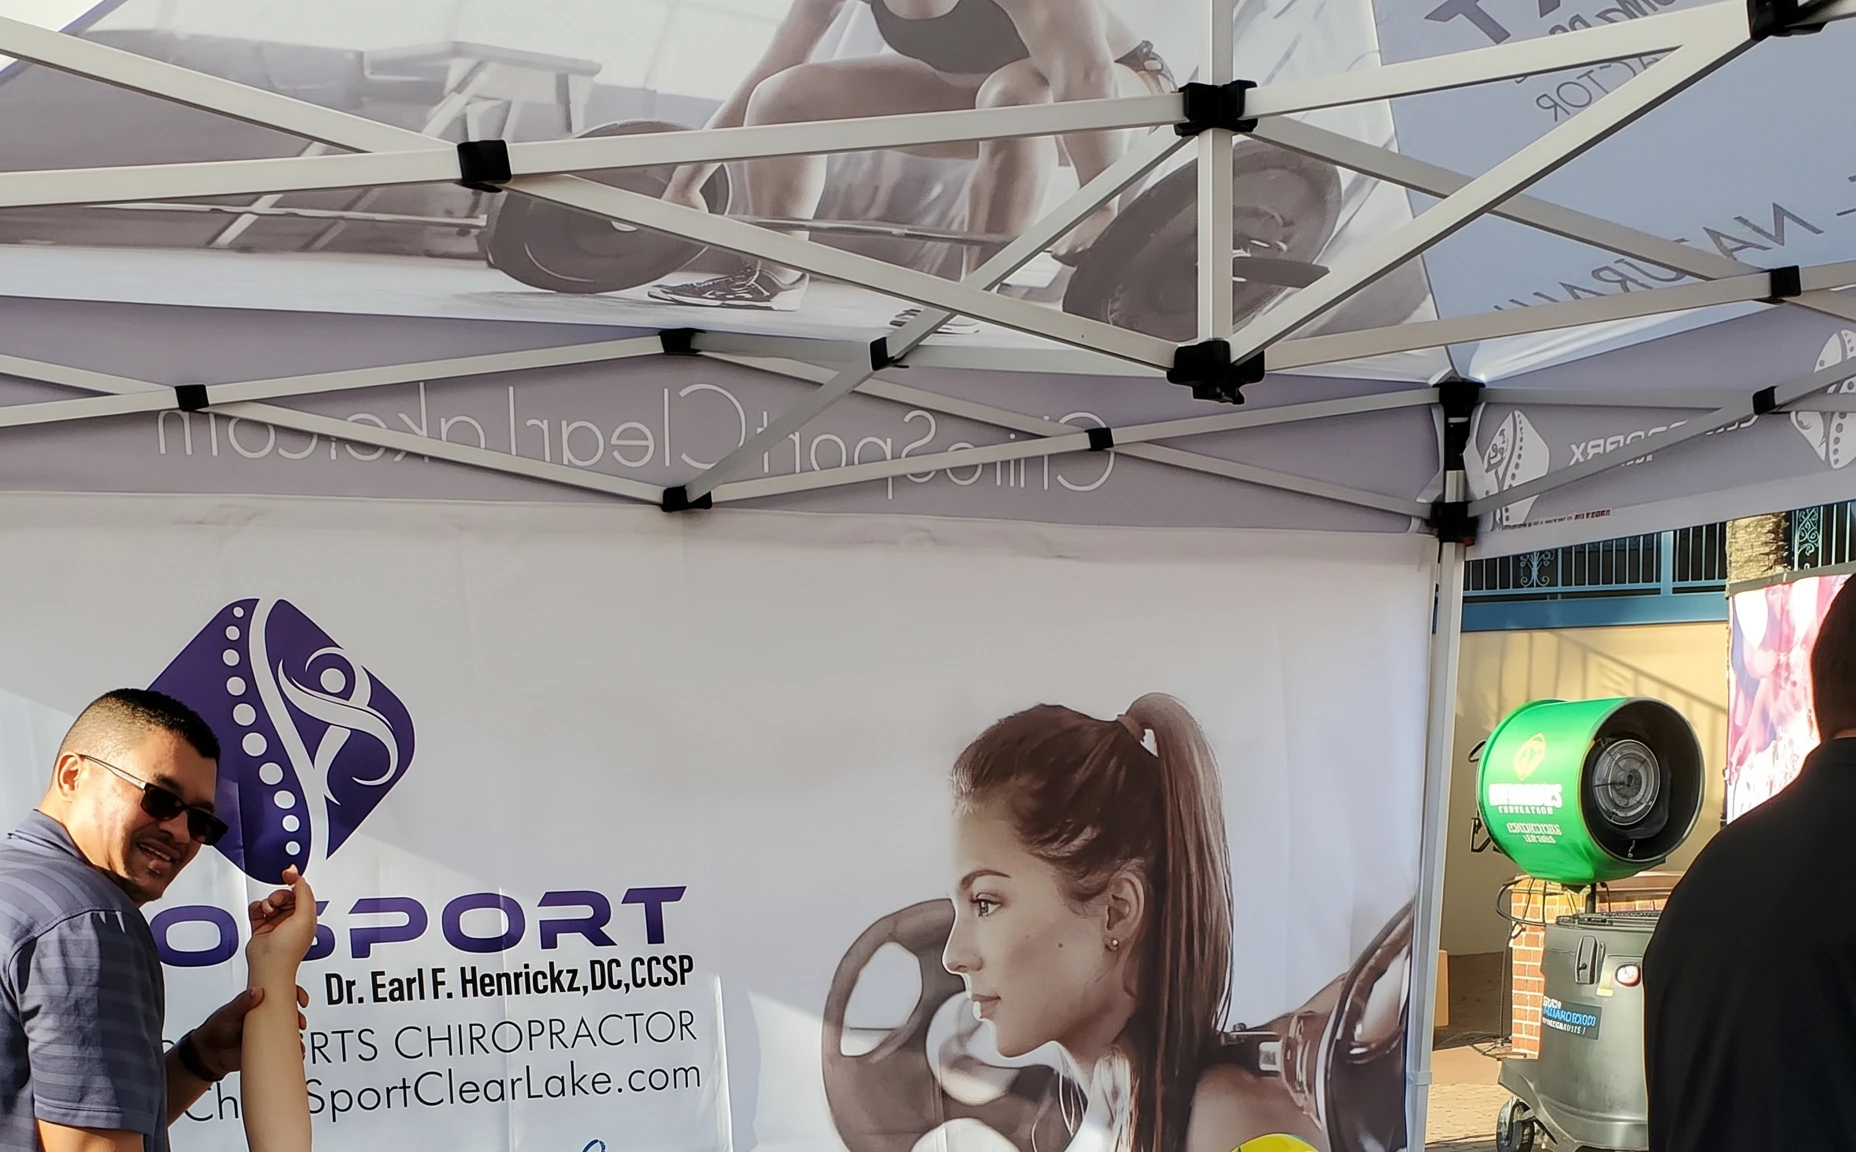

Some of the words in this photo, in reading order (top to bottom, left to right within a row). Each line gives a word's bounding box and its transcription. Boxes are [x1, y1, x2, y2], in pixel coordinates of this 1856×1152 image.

[325, 972, 364, 1005] Dr.
[370, 967, 425, 1003] Earl
[431, 967, 453, 999] F.
[394, 1009, 698, 1060] CHIROPRACTOR
